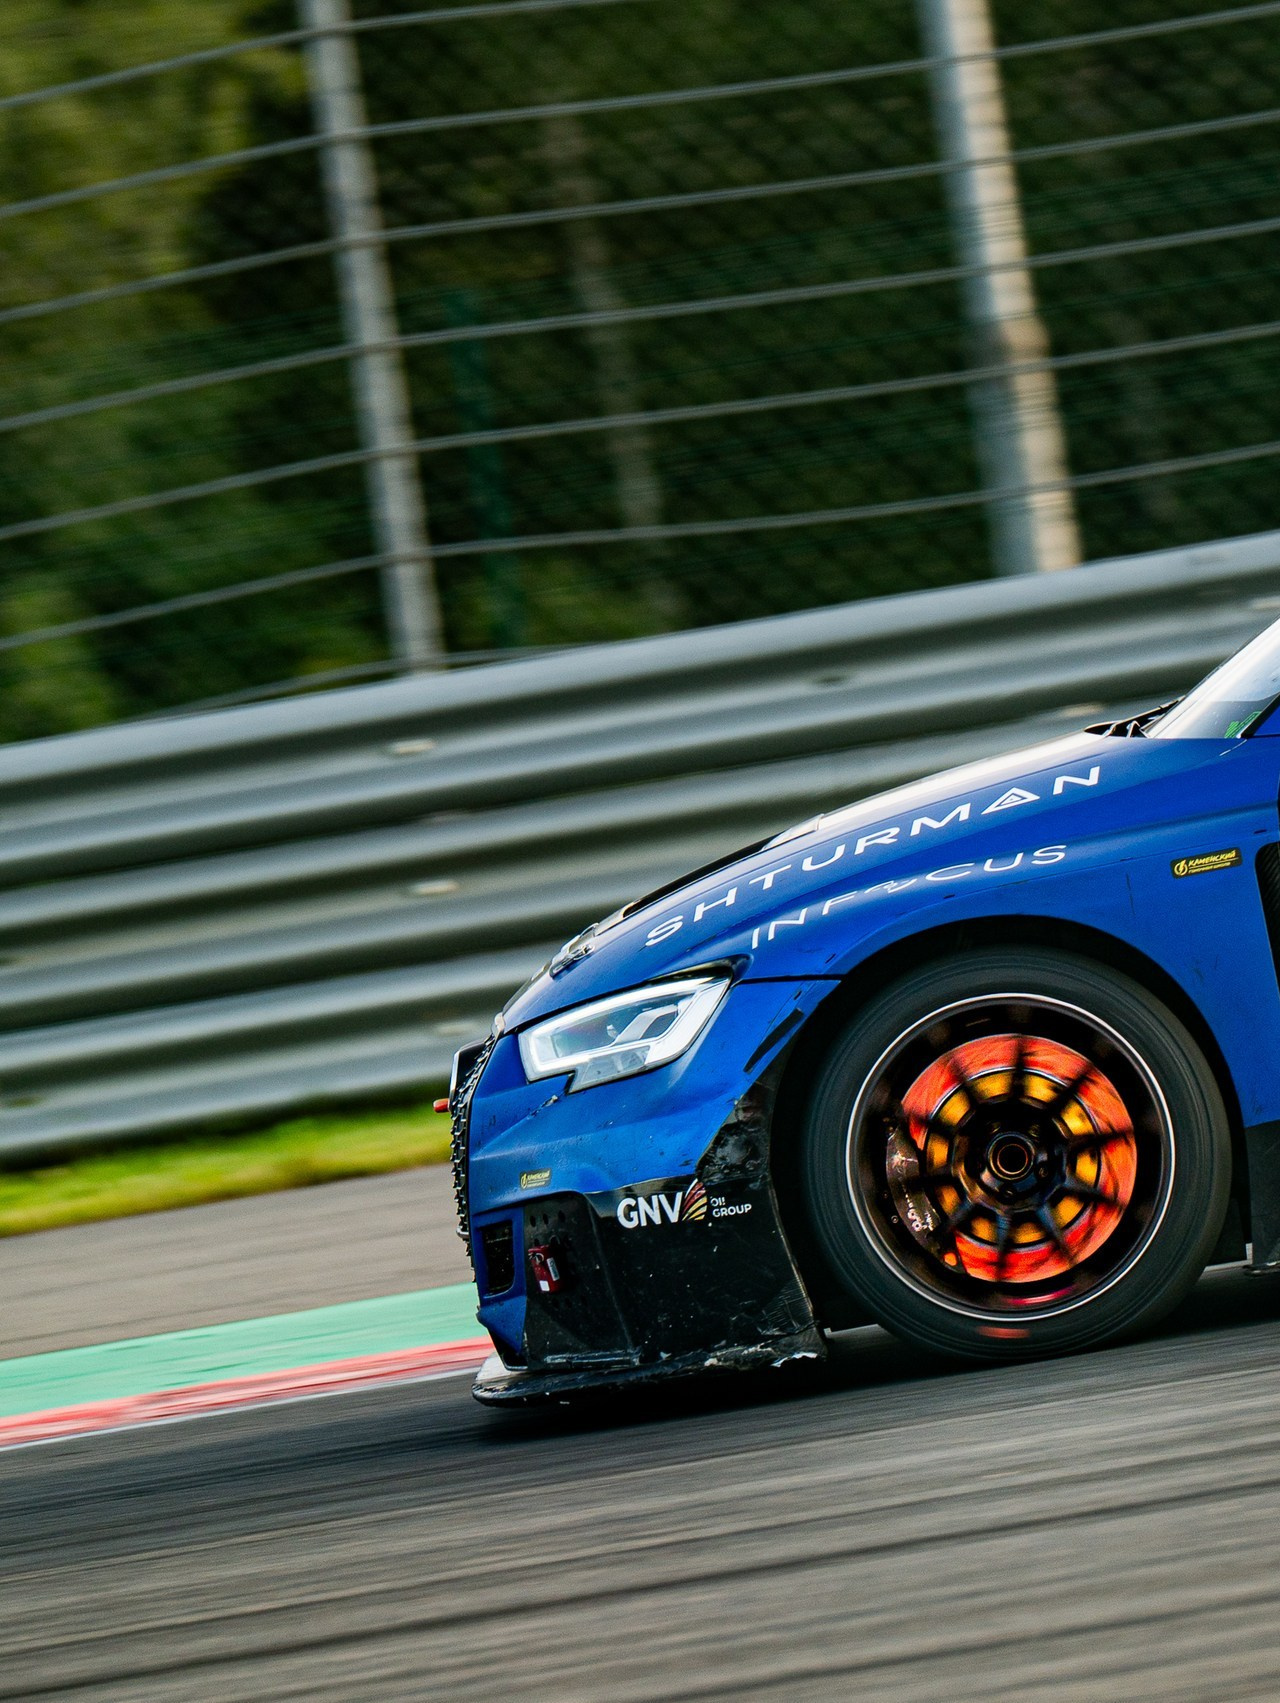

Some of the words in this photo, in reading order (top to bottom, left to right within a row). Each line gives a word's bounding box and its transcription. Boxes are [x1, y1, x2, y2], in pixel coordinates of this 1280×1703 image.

[644, 765, 1100, 947] SHTURMAN
[616, 1191, 683, 1230] GNV
[712, 1203, 753, 1218] GROUP
